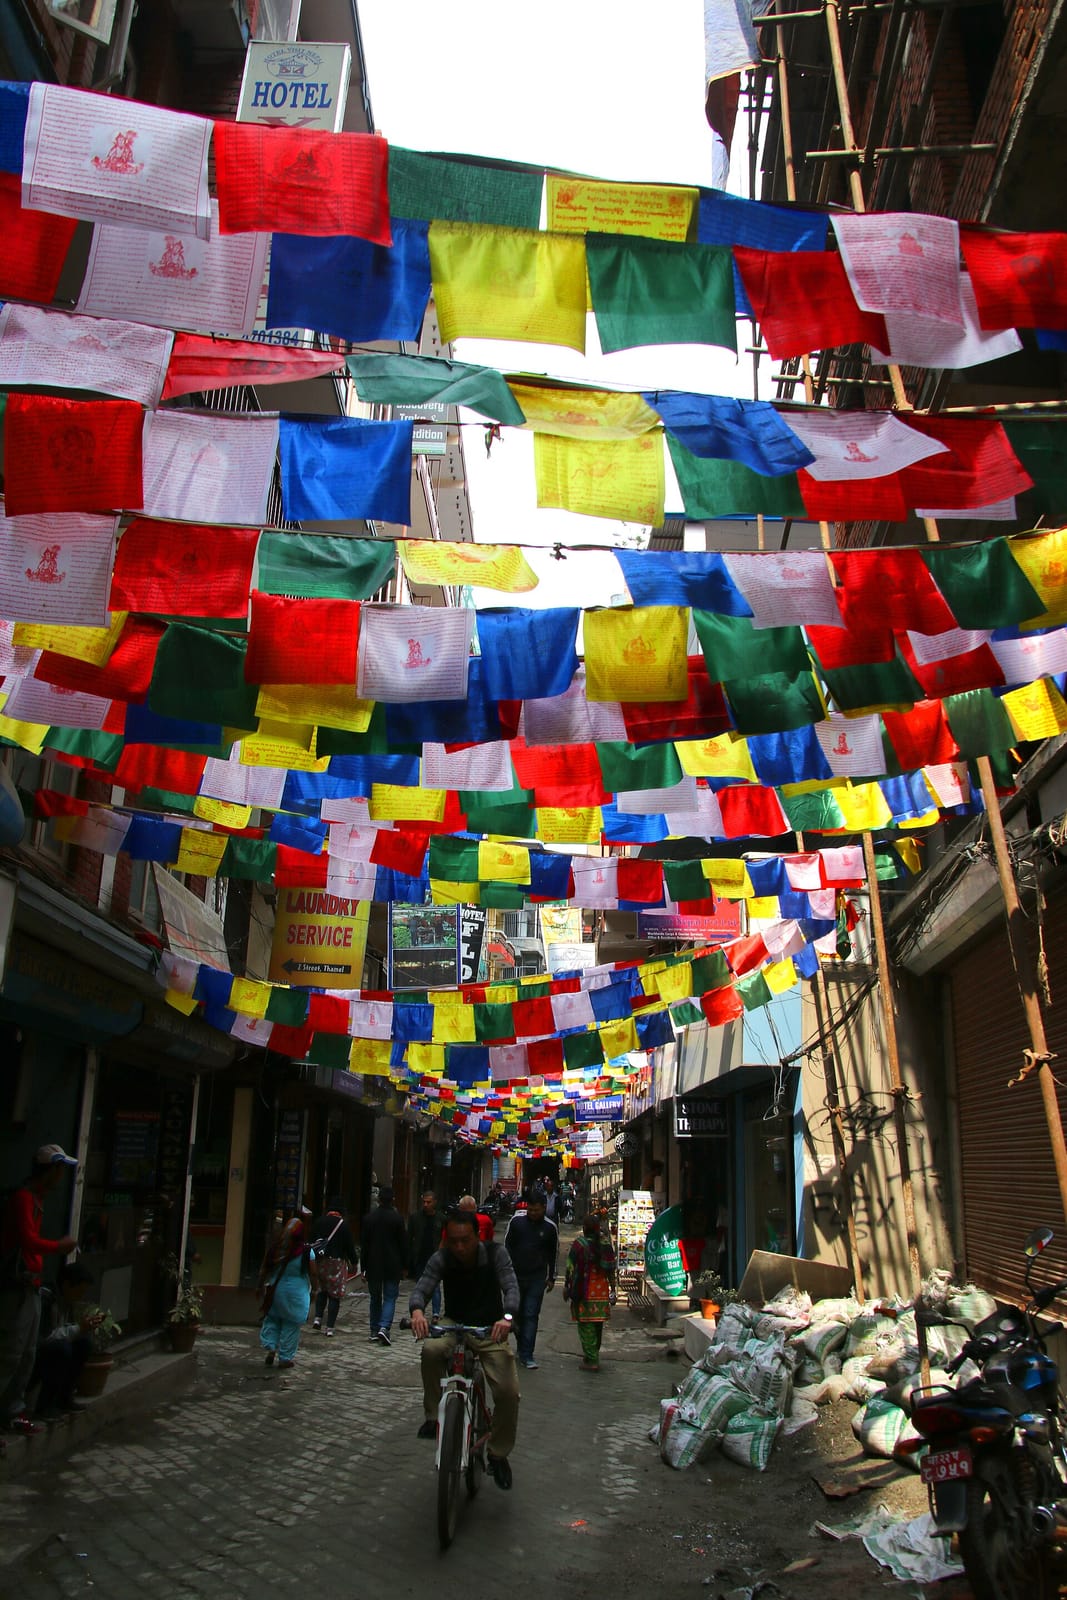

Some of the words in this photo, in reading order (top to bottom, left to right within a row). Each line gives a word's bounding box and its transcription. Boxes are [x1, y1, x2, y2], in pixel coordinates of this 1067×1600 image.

[251, 81, 332, 108] HOTEL
[413, 429, 443, 439] dition
[286, 891, 360, 916] LAUNDRY
[287, 924, 353, 947] SERVICE
[324, 965, 345, 973] Thamel
[576, 1101, 594, 1110] HOTEL
[681, 1102, 720, 1115] STONE
[677, 1117, 727, 1131] THERAPY
[667, 1260, 680, 1269] Bar
